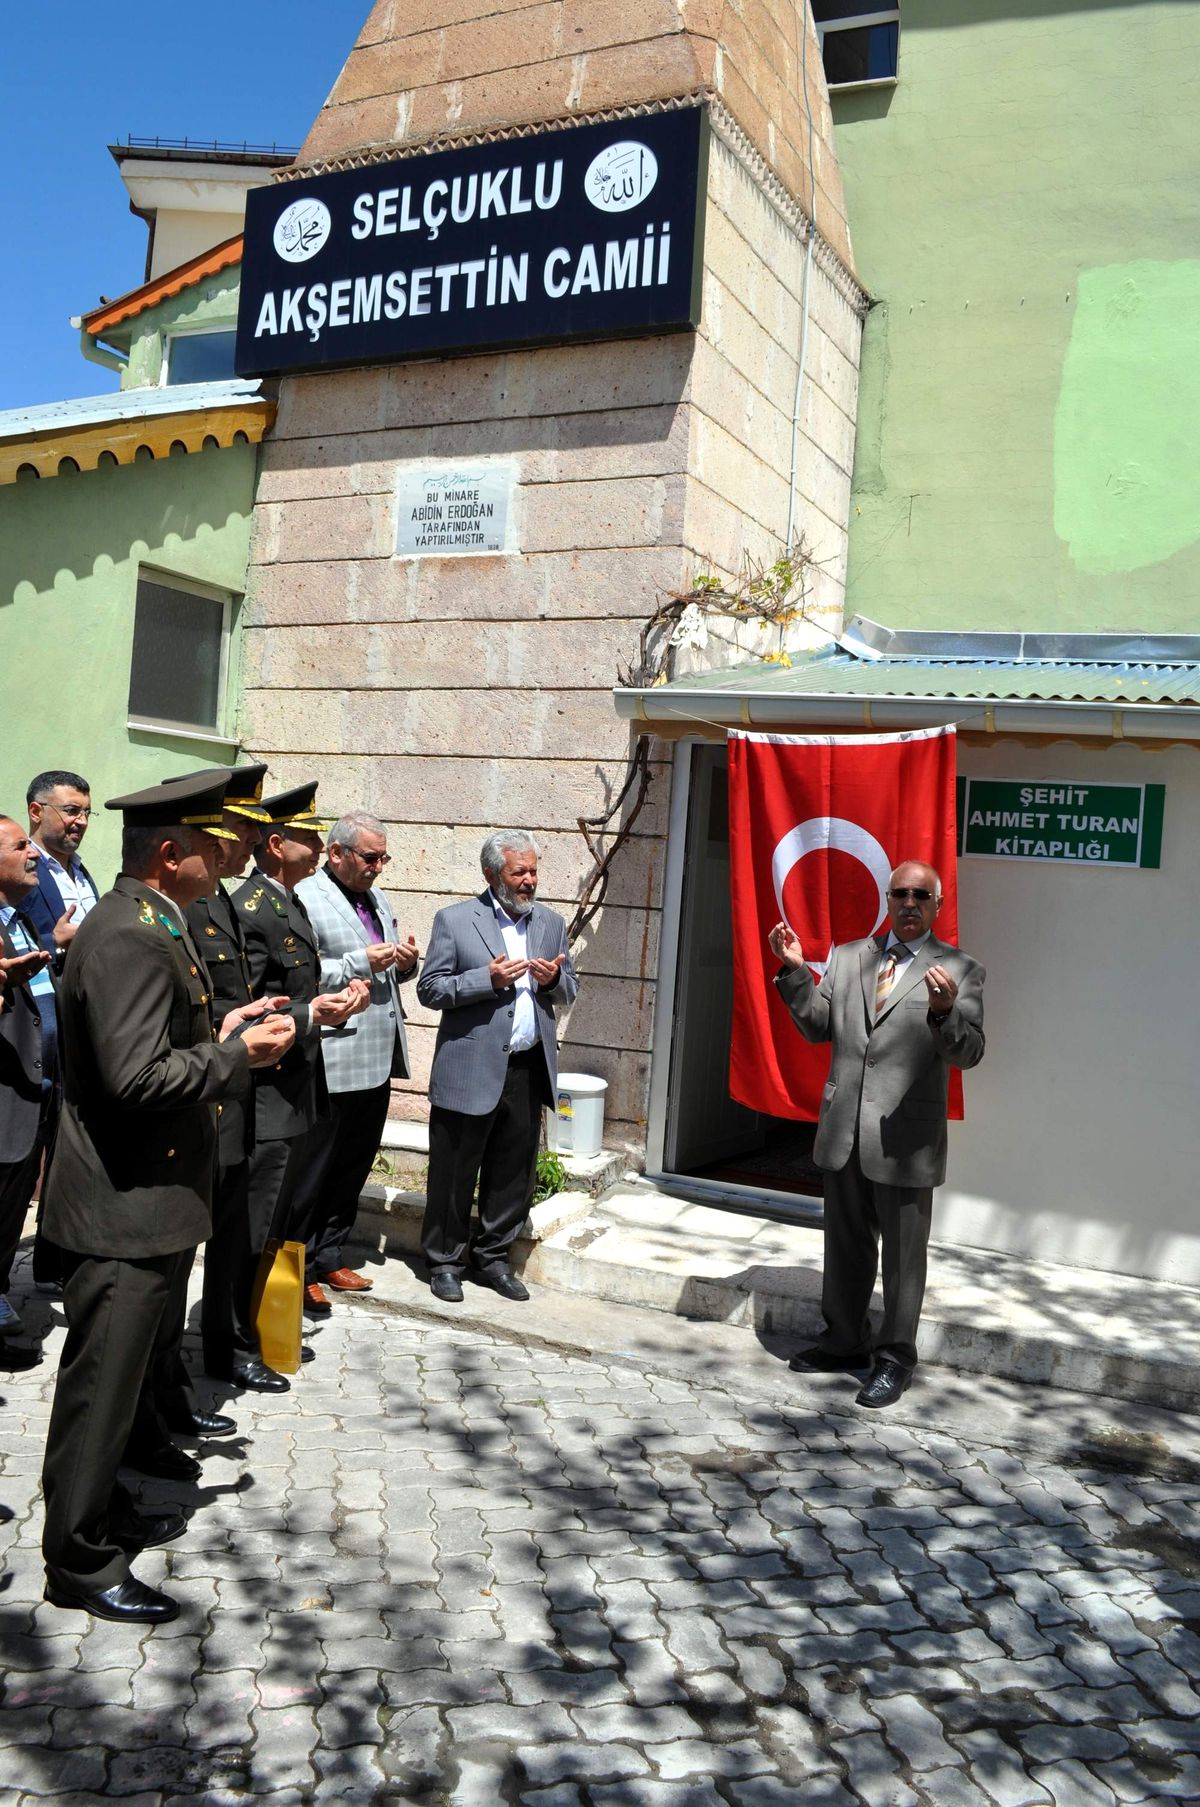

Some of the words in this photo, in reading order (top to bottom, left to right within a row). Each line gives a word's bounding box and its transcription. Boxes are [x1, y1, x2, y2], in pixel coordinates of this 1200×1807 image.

[351, 159, 564, 240] SELÇUKLU
[254, 244, 528, 343] AKŞEMSETTİN
[543, 221, 671, 299] CAMİİ
[426, 492, 439, 503] BU
[444, 489, 480, 502] MİNARE
[411, 505, 443, 521] ABİDİN
[448, 501, 494, 519] ERDOĞAN
[422, 520, 481, 533] TARAFINDAN
[415, 533, 485, 547] YAPTIRILMIŞTIR
[1019, 785, 1089, 807] ŞEHİT
[969, 810, 1050, 829] AHMET
[1057, 814, 1138, 834] TURAN
[995, 835, 1110, 860] KİTAPLIĞI
